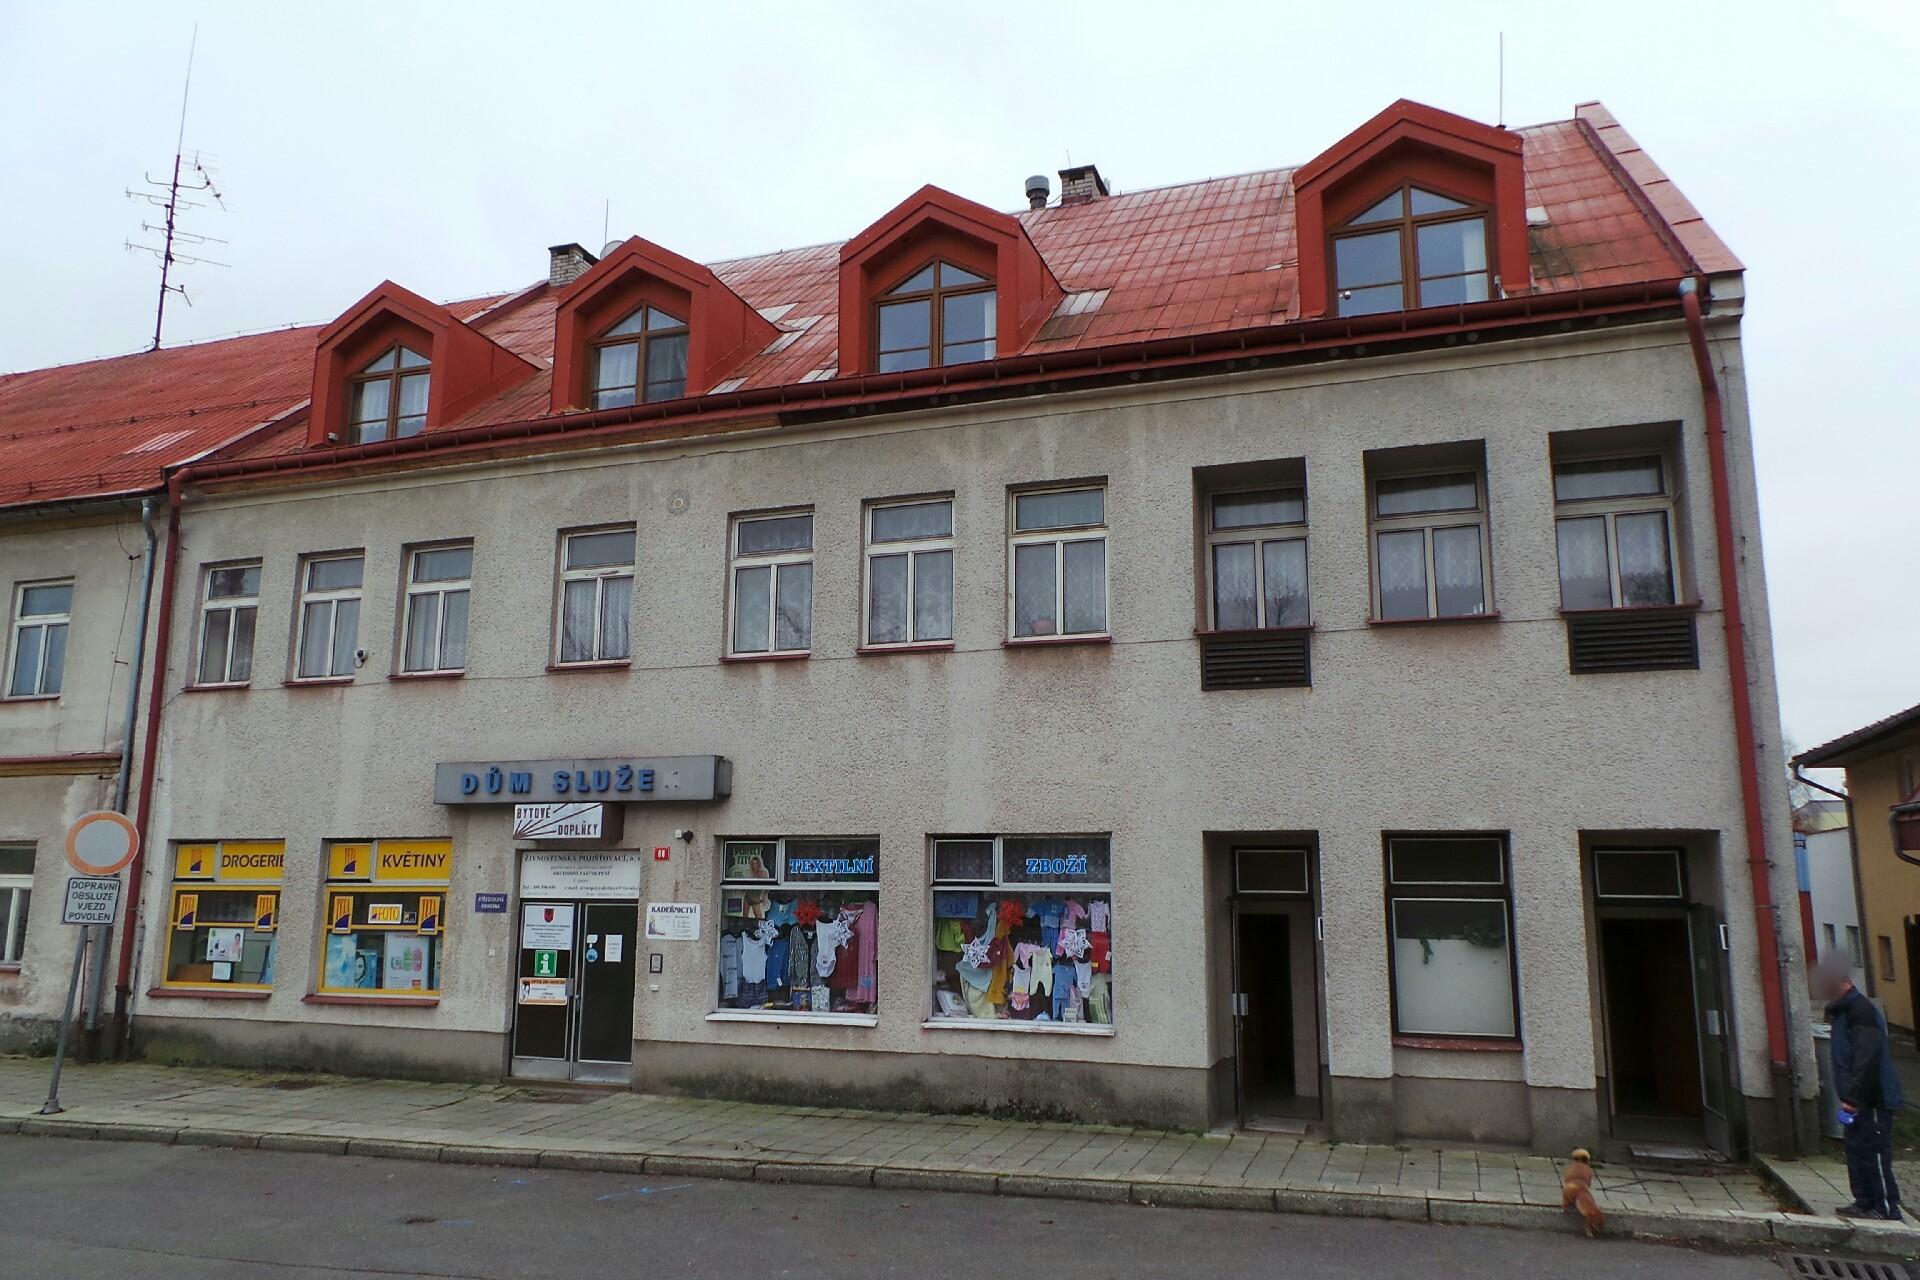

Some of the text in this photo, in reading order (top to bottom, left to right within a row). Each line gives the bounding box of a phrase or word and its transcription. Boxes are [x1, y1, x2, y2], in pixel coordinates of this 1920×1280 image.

[461, 765, 656, 794] DŮM SLUŽE
[516, 804, 551, 819] BYTOVÉ
[557, 820, 599, 836] DOPLŇKY
[382, 851, 446, 868] KVĚTINY
[789, 855, 875, 874] TEXTILNÍ
[1025, 854, 1087, 875] ZBOŽÍ
[71, 881, 118, 891] DOPRAVNÍ
[72, 892, 114, 901] OBSLUZE
[77, 902, 106, 911] VJEZD
[68, 912, 111, 921] POVOLEN
[378, 908, 399, 921] FOTO
